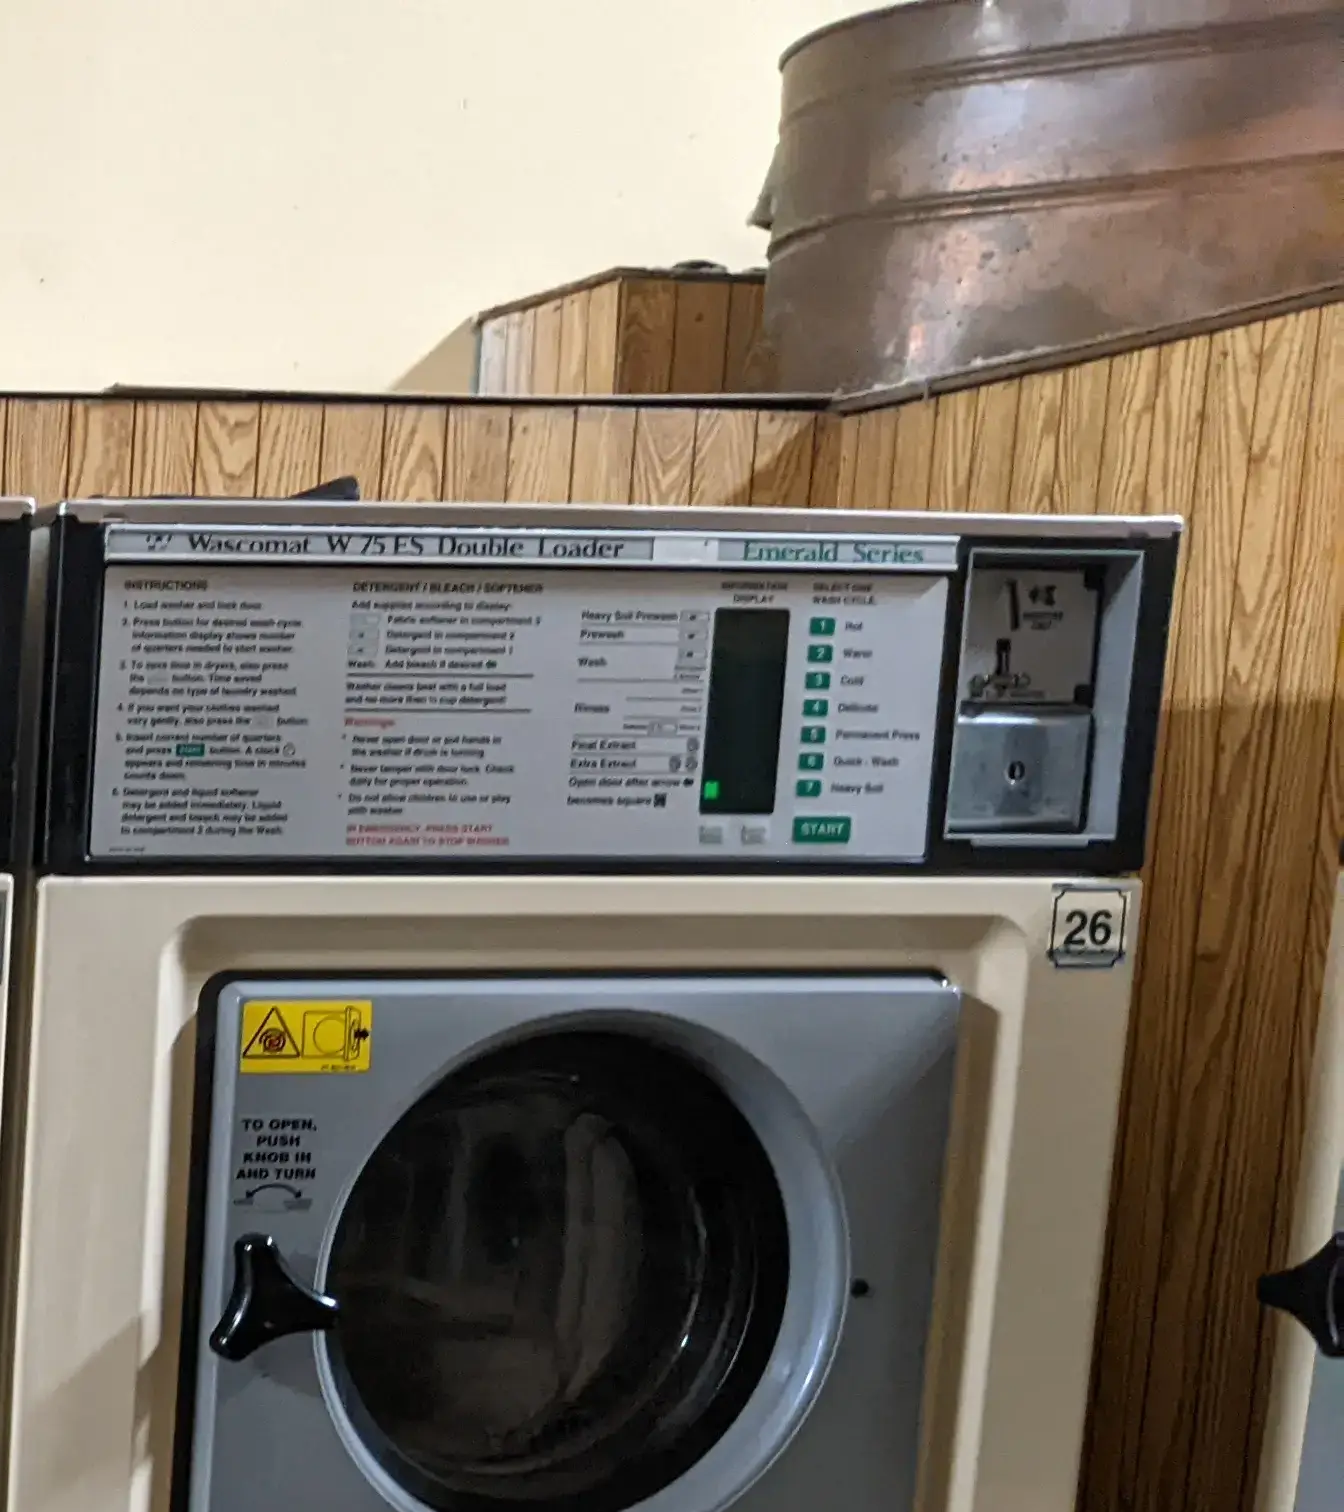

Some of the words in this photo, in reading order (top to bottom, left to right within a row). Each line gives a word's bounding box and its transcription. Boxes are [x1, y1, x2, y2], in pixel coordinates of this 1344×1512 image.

[188, 532, 310, 553] Wascomat
[438, 536, 524, 557] Double
[538, 537, 624, 559] Loader
[743, 540, 838, 563] Emerald
[853, 542, 923, 565] Series
[819, 621, 826, 631] 1
[845, 621, 863, 631] Hot
[816, 648, 825, 659] 2
[844, 649, 872, 658] Warm
[841, 676, 864, 686] Cold
[812, 702, 820, 713] 4
[838, 703, 878, 713] Delicate
[835, 730, 889, 740] Permanent
[891, 731, 920, 741] Press
[871, 757, 899, 767] Wash
[831, 783, 861, 795] Heavy
[801, 822, 845, 836] START
[1064, 909, 1112, 945] 26
[242, 1118, 264, 1132] TO
[268, 1119, 317, 1132] OPEN,
[256, 1135, 300, 1147] PUSH
[243, 1151, 290, 1163] KNOB
[295, 1152, 311, 1163] IN
[236, 1168, 269, 1180] AND
[275, 1169, 316, 1180] TURN
